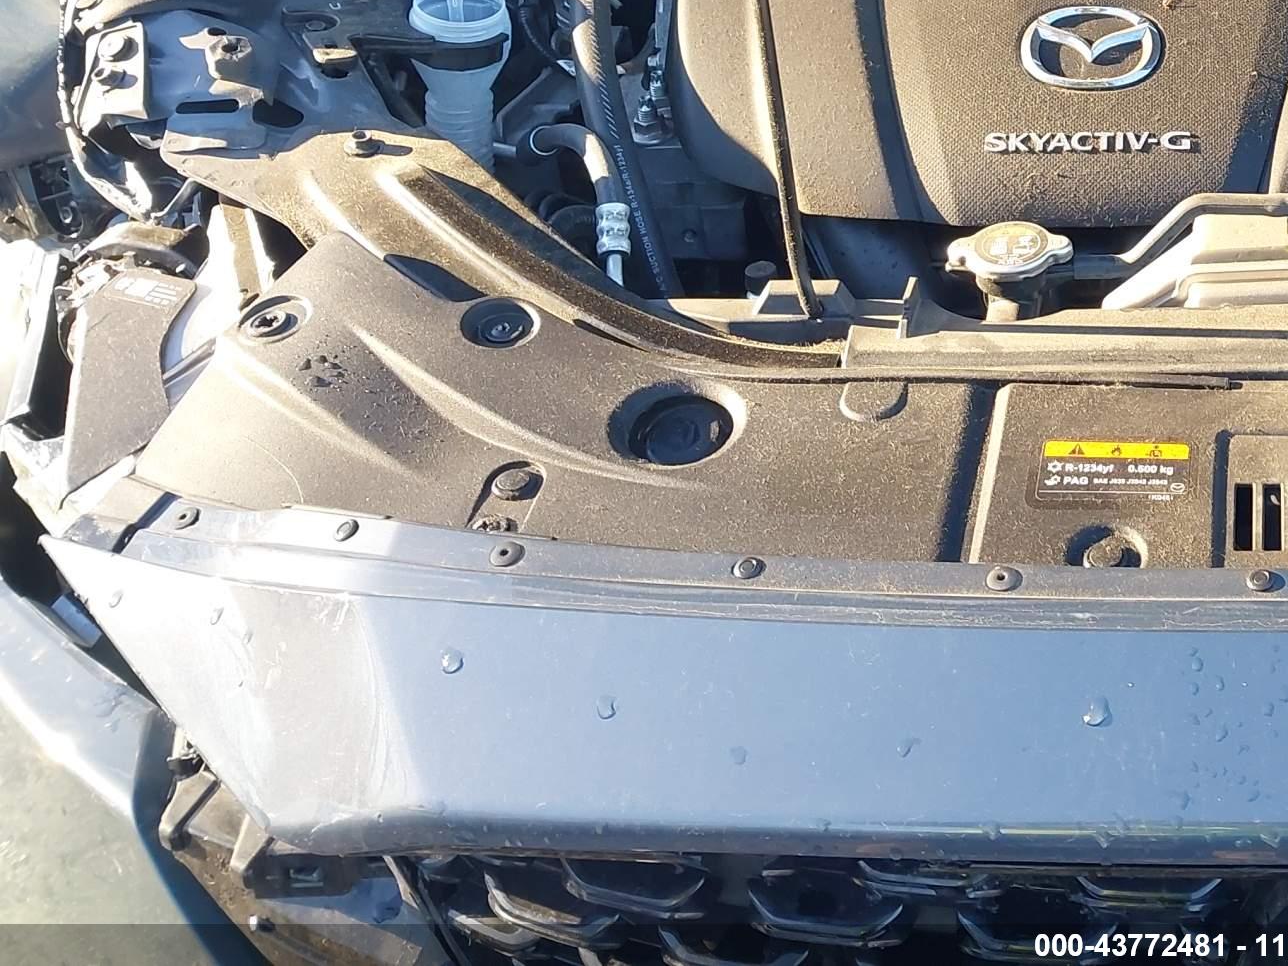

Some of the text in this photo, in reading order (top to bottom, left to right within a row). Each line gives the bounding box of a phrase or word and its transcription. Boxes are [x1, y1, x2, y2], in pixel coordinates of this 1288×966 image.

[984, 131, 1192, 152] SKYACTIV-G
[633, 209, 647, 234] HOSE
[1065, 463, 1114, 474] R-1234yf
[1159, 464, 1174, 476] kg
[1062, 476, 1089, 485] PAG
